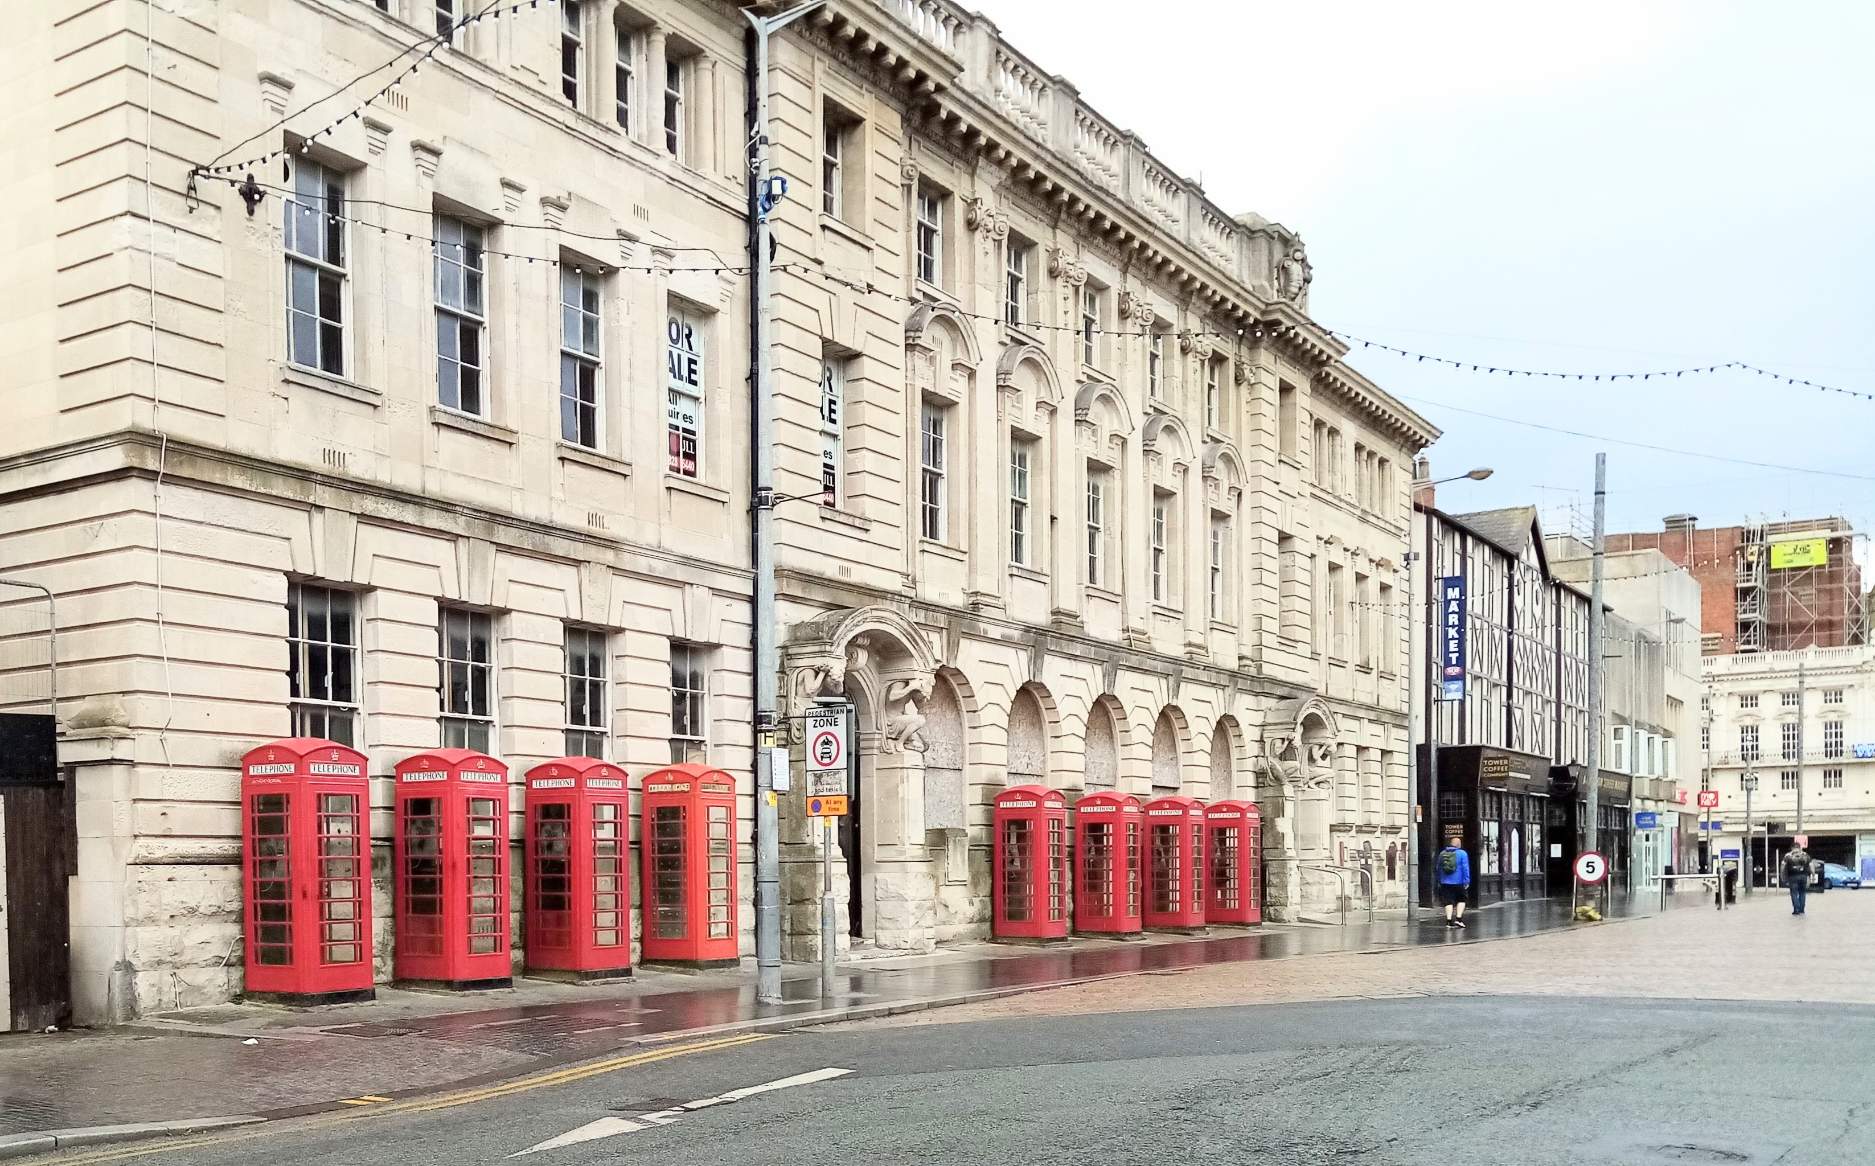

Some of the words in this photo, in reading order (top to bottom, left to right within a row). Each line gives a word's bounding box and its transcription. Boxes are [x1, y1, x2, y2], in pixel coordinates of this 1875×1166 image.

[1446, 586, 1460, 665] MARKET
[807, 708, 845, 717] PEDESTRIAN
[813, 718, 839, 728] ZONE
[252, 764, 293, 774] TELEPHONE
[313, 764, 358, 774] TELEPHONE
[405, 772, 447, 781] TELEPHONE
[461, 772, 500, 781] TELEPHONE
[535, 779, 574, 787] TELEPHONE
[1585, 861, 1596, 874] 5
